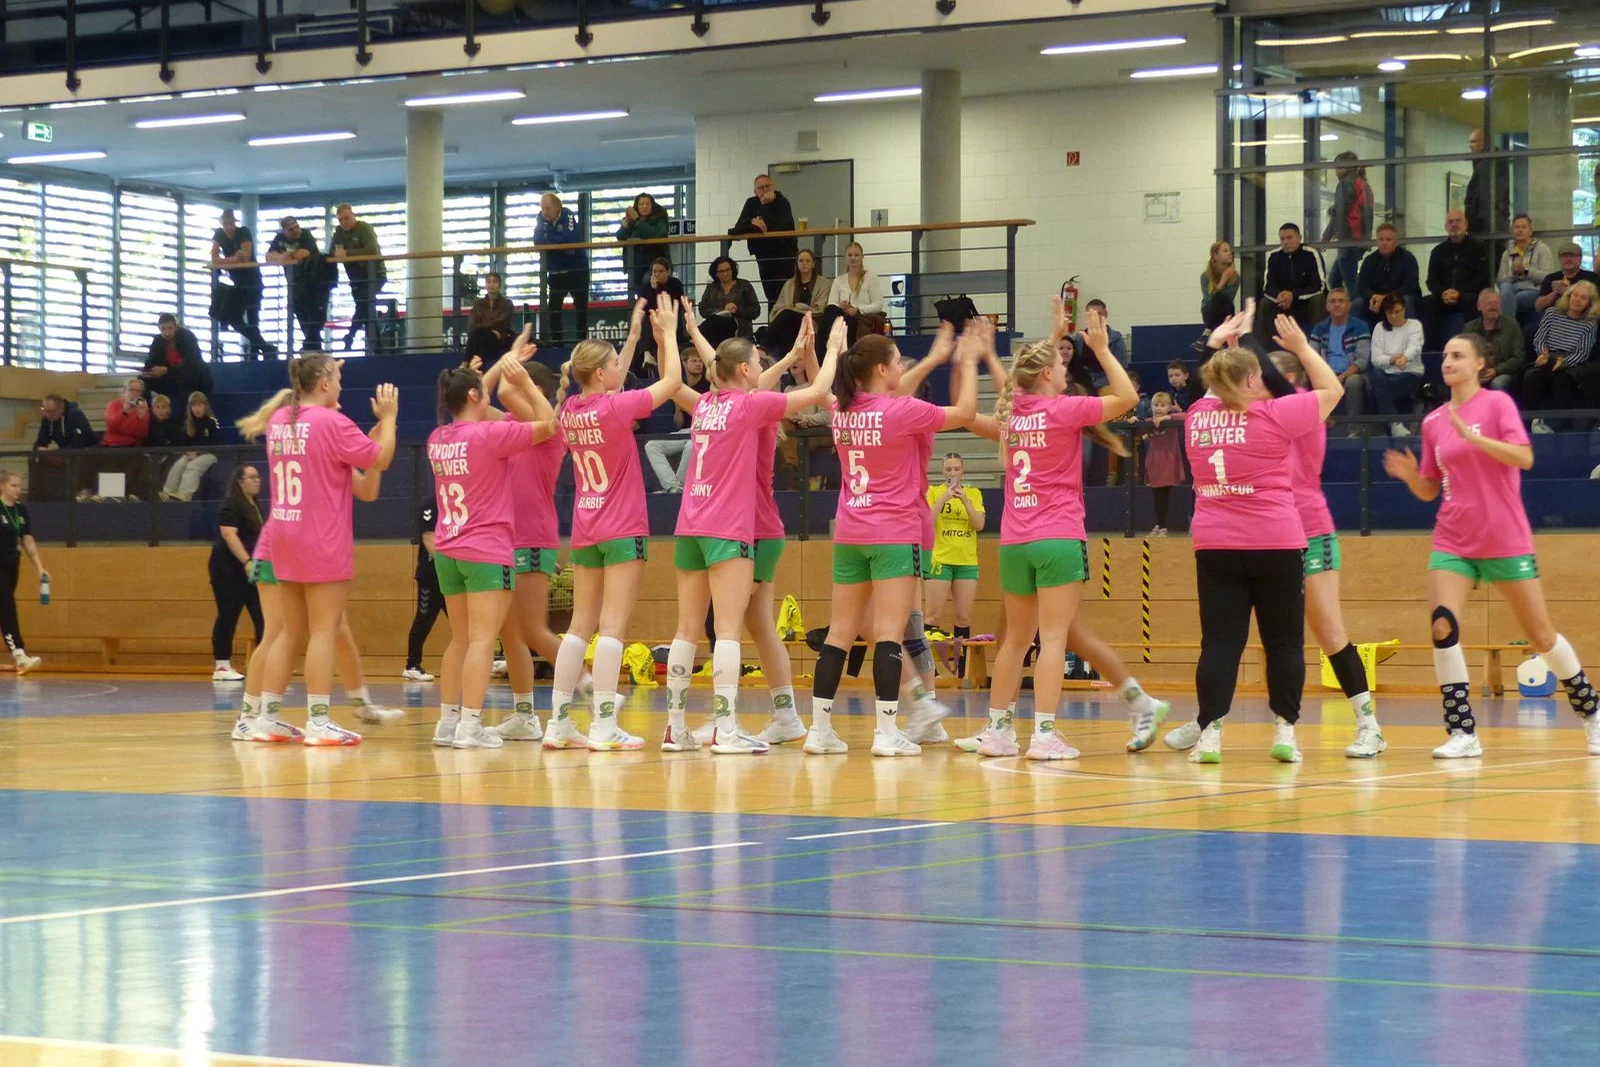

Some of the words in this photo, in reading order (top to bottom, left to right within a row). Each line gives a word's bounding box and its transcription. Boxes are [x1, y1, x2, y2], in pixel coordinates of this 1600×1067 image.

[1190, 410, 1248, 430] ZWOOTE
[573, 450, 608, 493] 10
[695, 434, 710, 480] 7
[848, 450, 870, 495] 5
[1013, 450, 1032, 493] 2
[1208, 449, 1228, 484] 1
[274, 461, 302, 505] 16
[440, 483, 469, 526] 13
[1013, 494, 1038, 508] CARO
